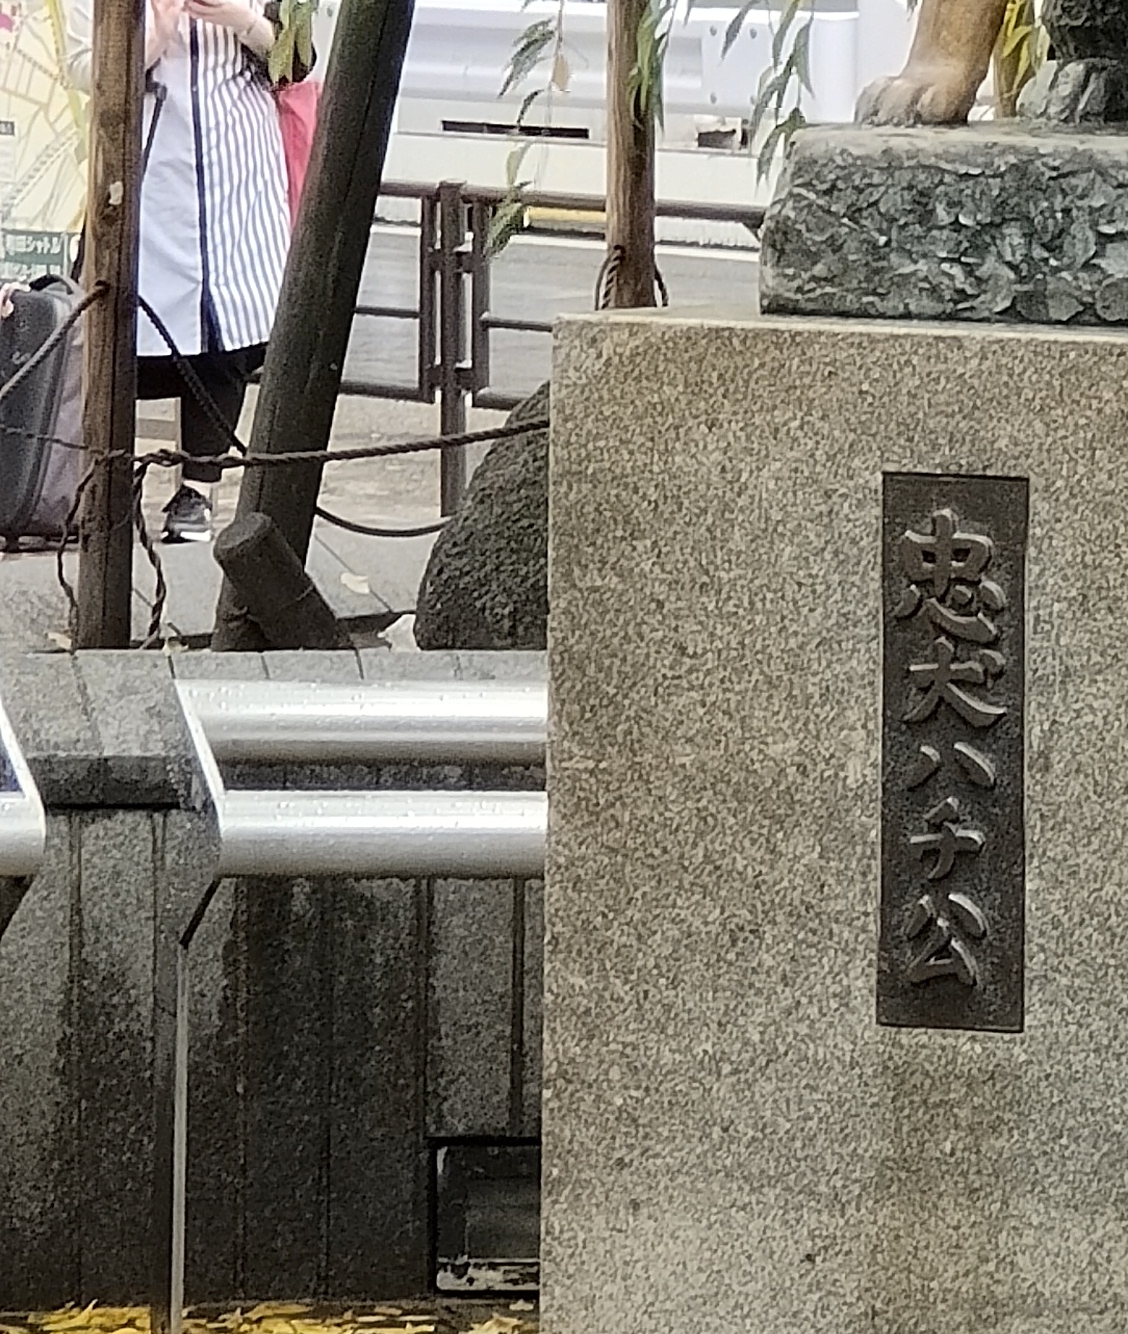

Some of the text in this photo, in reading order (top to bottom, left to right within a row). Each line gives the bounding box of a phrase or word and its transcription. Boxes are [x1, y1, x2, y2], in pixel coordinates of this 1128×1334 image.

[896, 507, 1008, 988] 忠犬ハチ公
